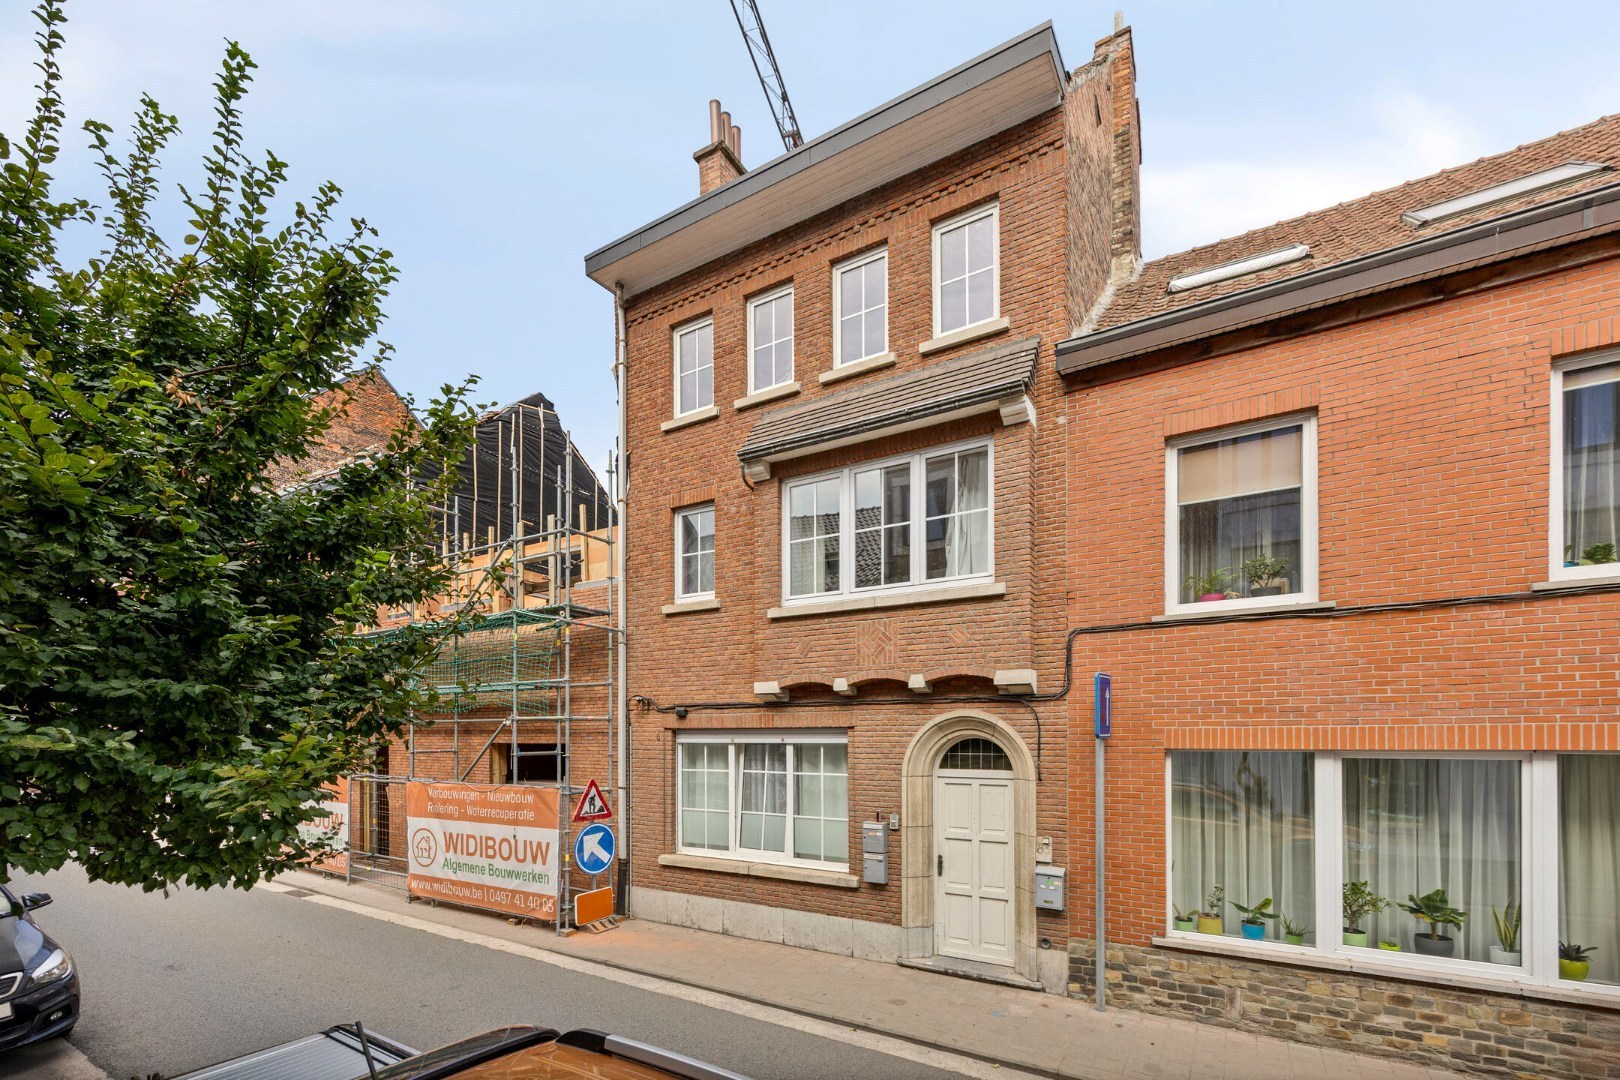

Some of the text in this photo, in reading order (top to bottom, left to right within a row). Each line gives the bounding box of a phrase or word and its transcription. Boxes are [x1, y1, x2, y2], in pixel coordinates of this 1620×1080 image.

[428, 787, 480, 802] Verbouwingen
[487, 791, 535, 804] Nieuwbouw
[466, 804, 535, 821] Waterrecuperatie
[443, 831, 551, 866] WIDIBOUW
[338, 856, 346, 868] 05
[442, 857, 550, 885] Algemene Bouwwerken
[411, 878, 483, 900] www.widibouw.be
[490, 889, 512, 905] 0497
[514, 894, 525, 908] 41
[527, 896, 540, 910] 40
[542, 898, 554, 913] 05
